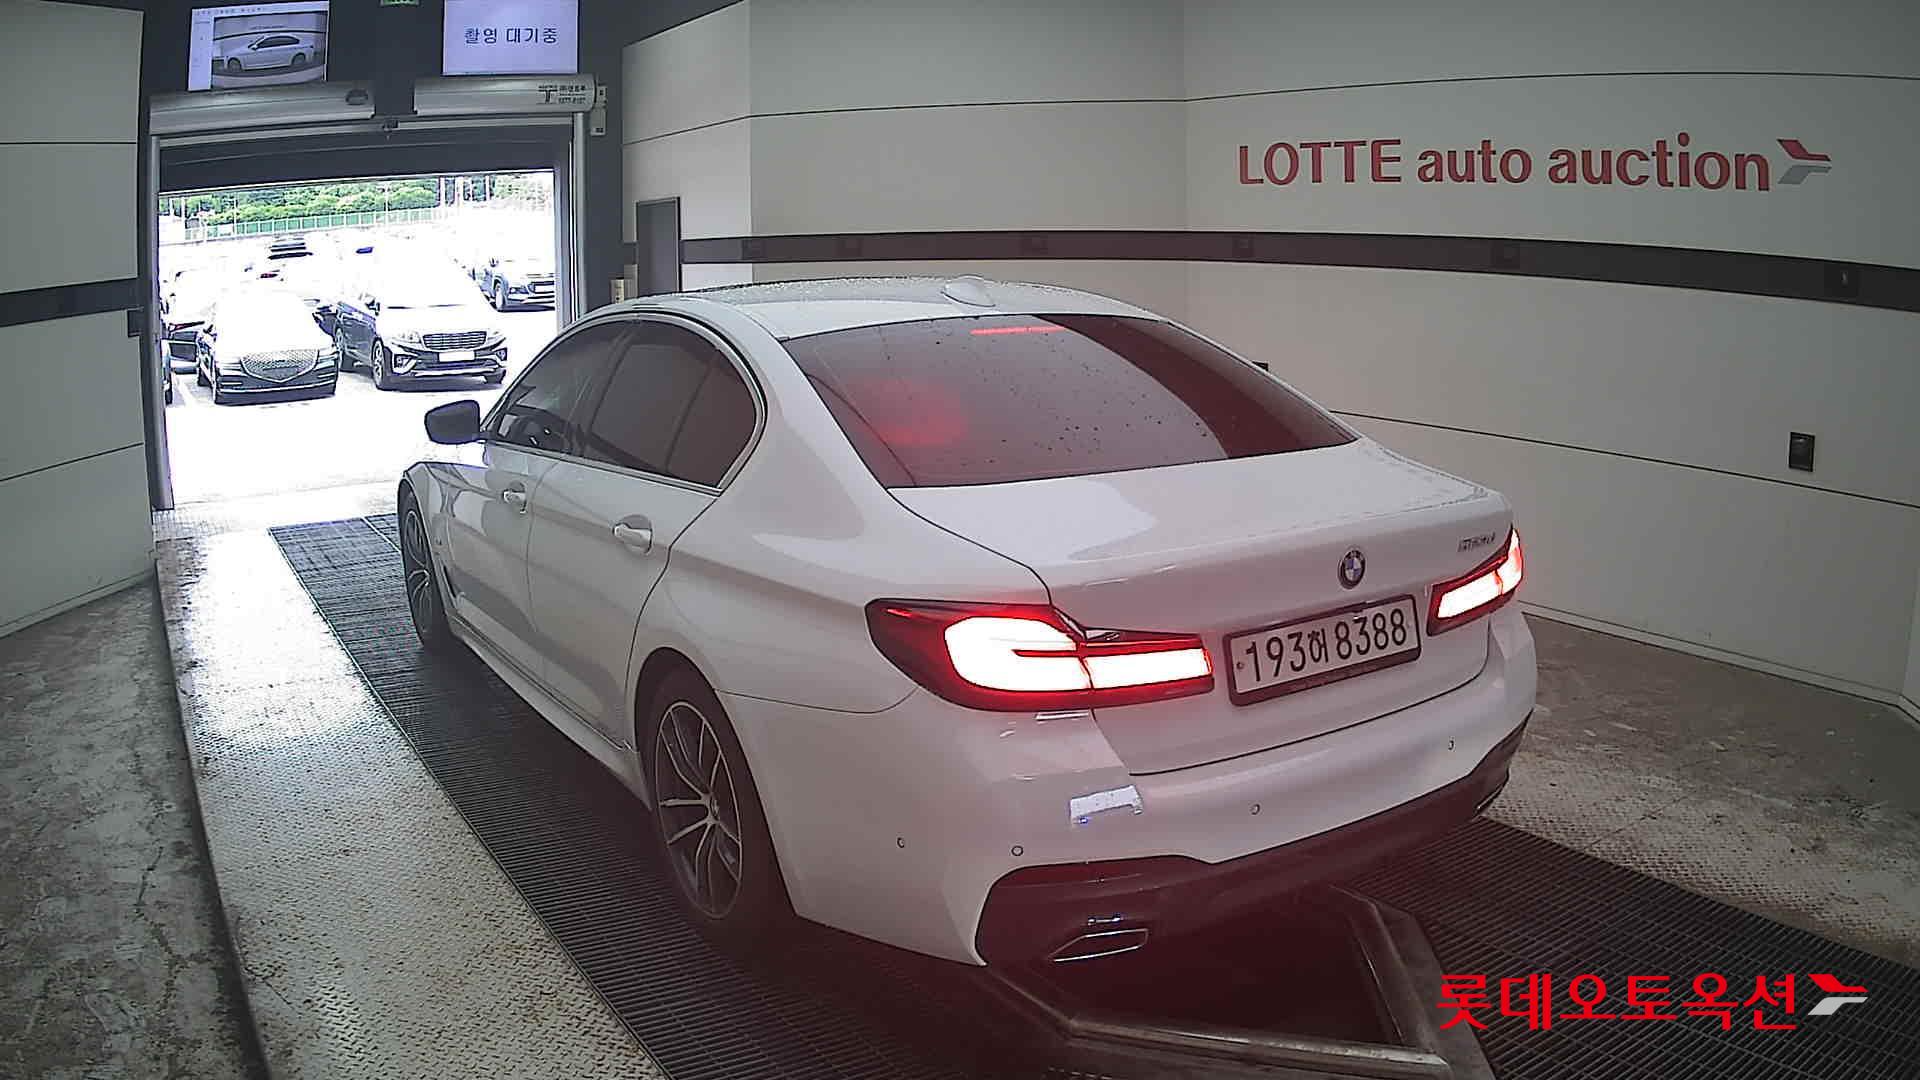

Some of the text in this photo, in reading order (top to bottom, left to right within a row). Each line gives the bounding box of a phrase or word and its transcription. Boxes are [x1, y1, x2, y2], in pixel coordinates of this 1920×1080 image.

[464, 27, 557, 44] 촬영 대기중
[1238, 132, 1770, 191] LOTTE auto auction
[1334, 608, 1407, 660] 8388
